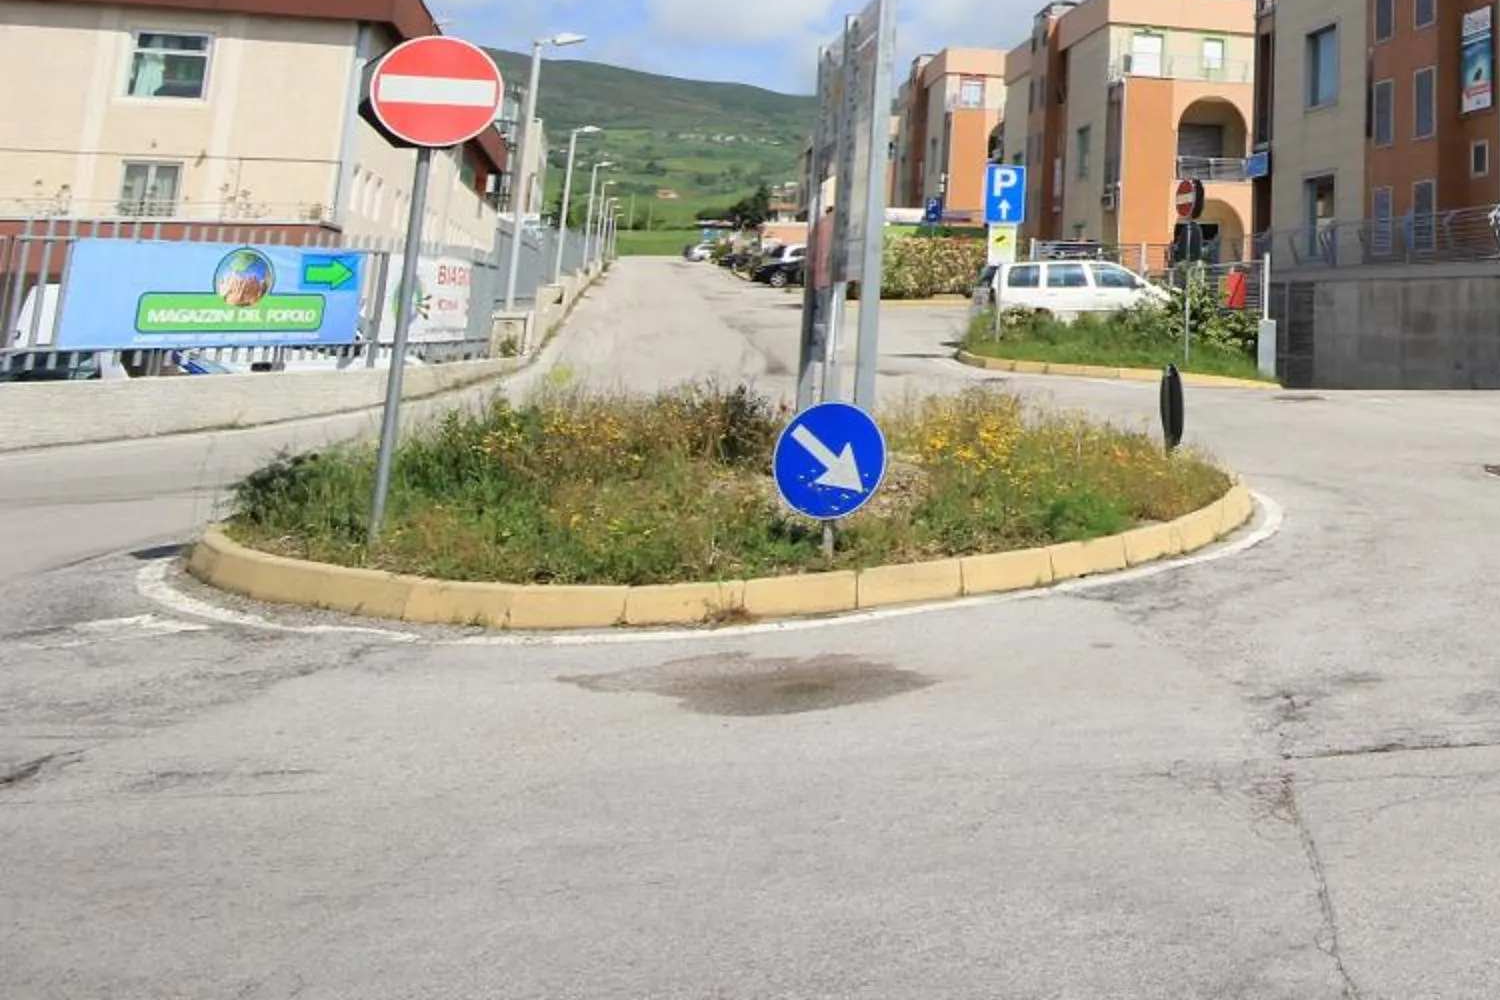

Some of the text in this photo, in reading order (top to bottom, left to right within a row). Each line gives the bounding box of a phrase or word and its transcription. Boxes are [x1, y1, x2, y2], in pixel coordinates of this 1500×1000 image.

[992, 169, 1017, 196] P
[147, 308, 317, 323] MAGAZZINI DEL POPOLO
